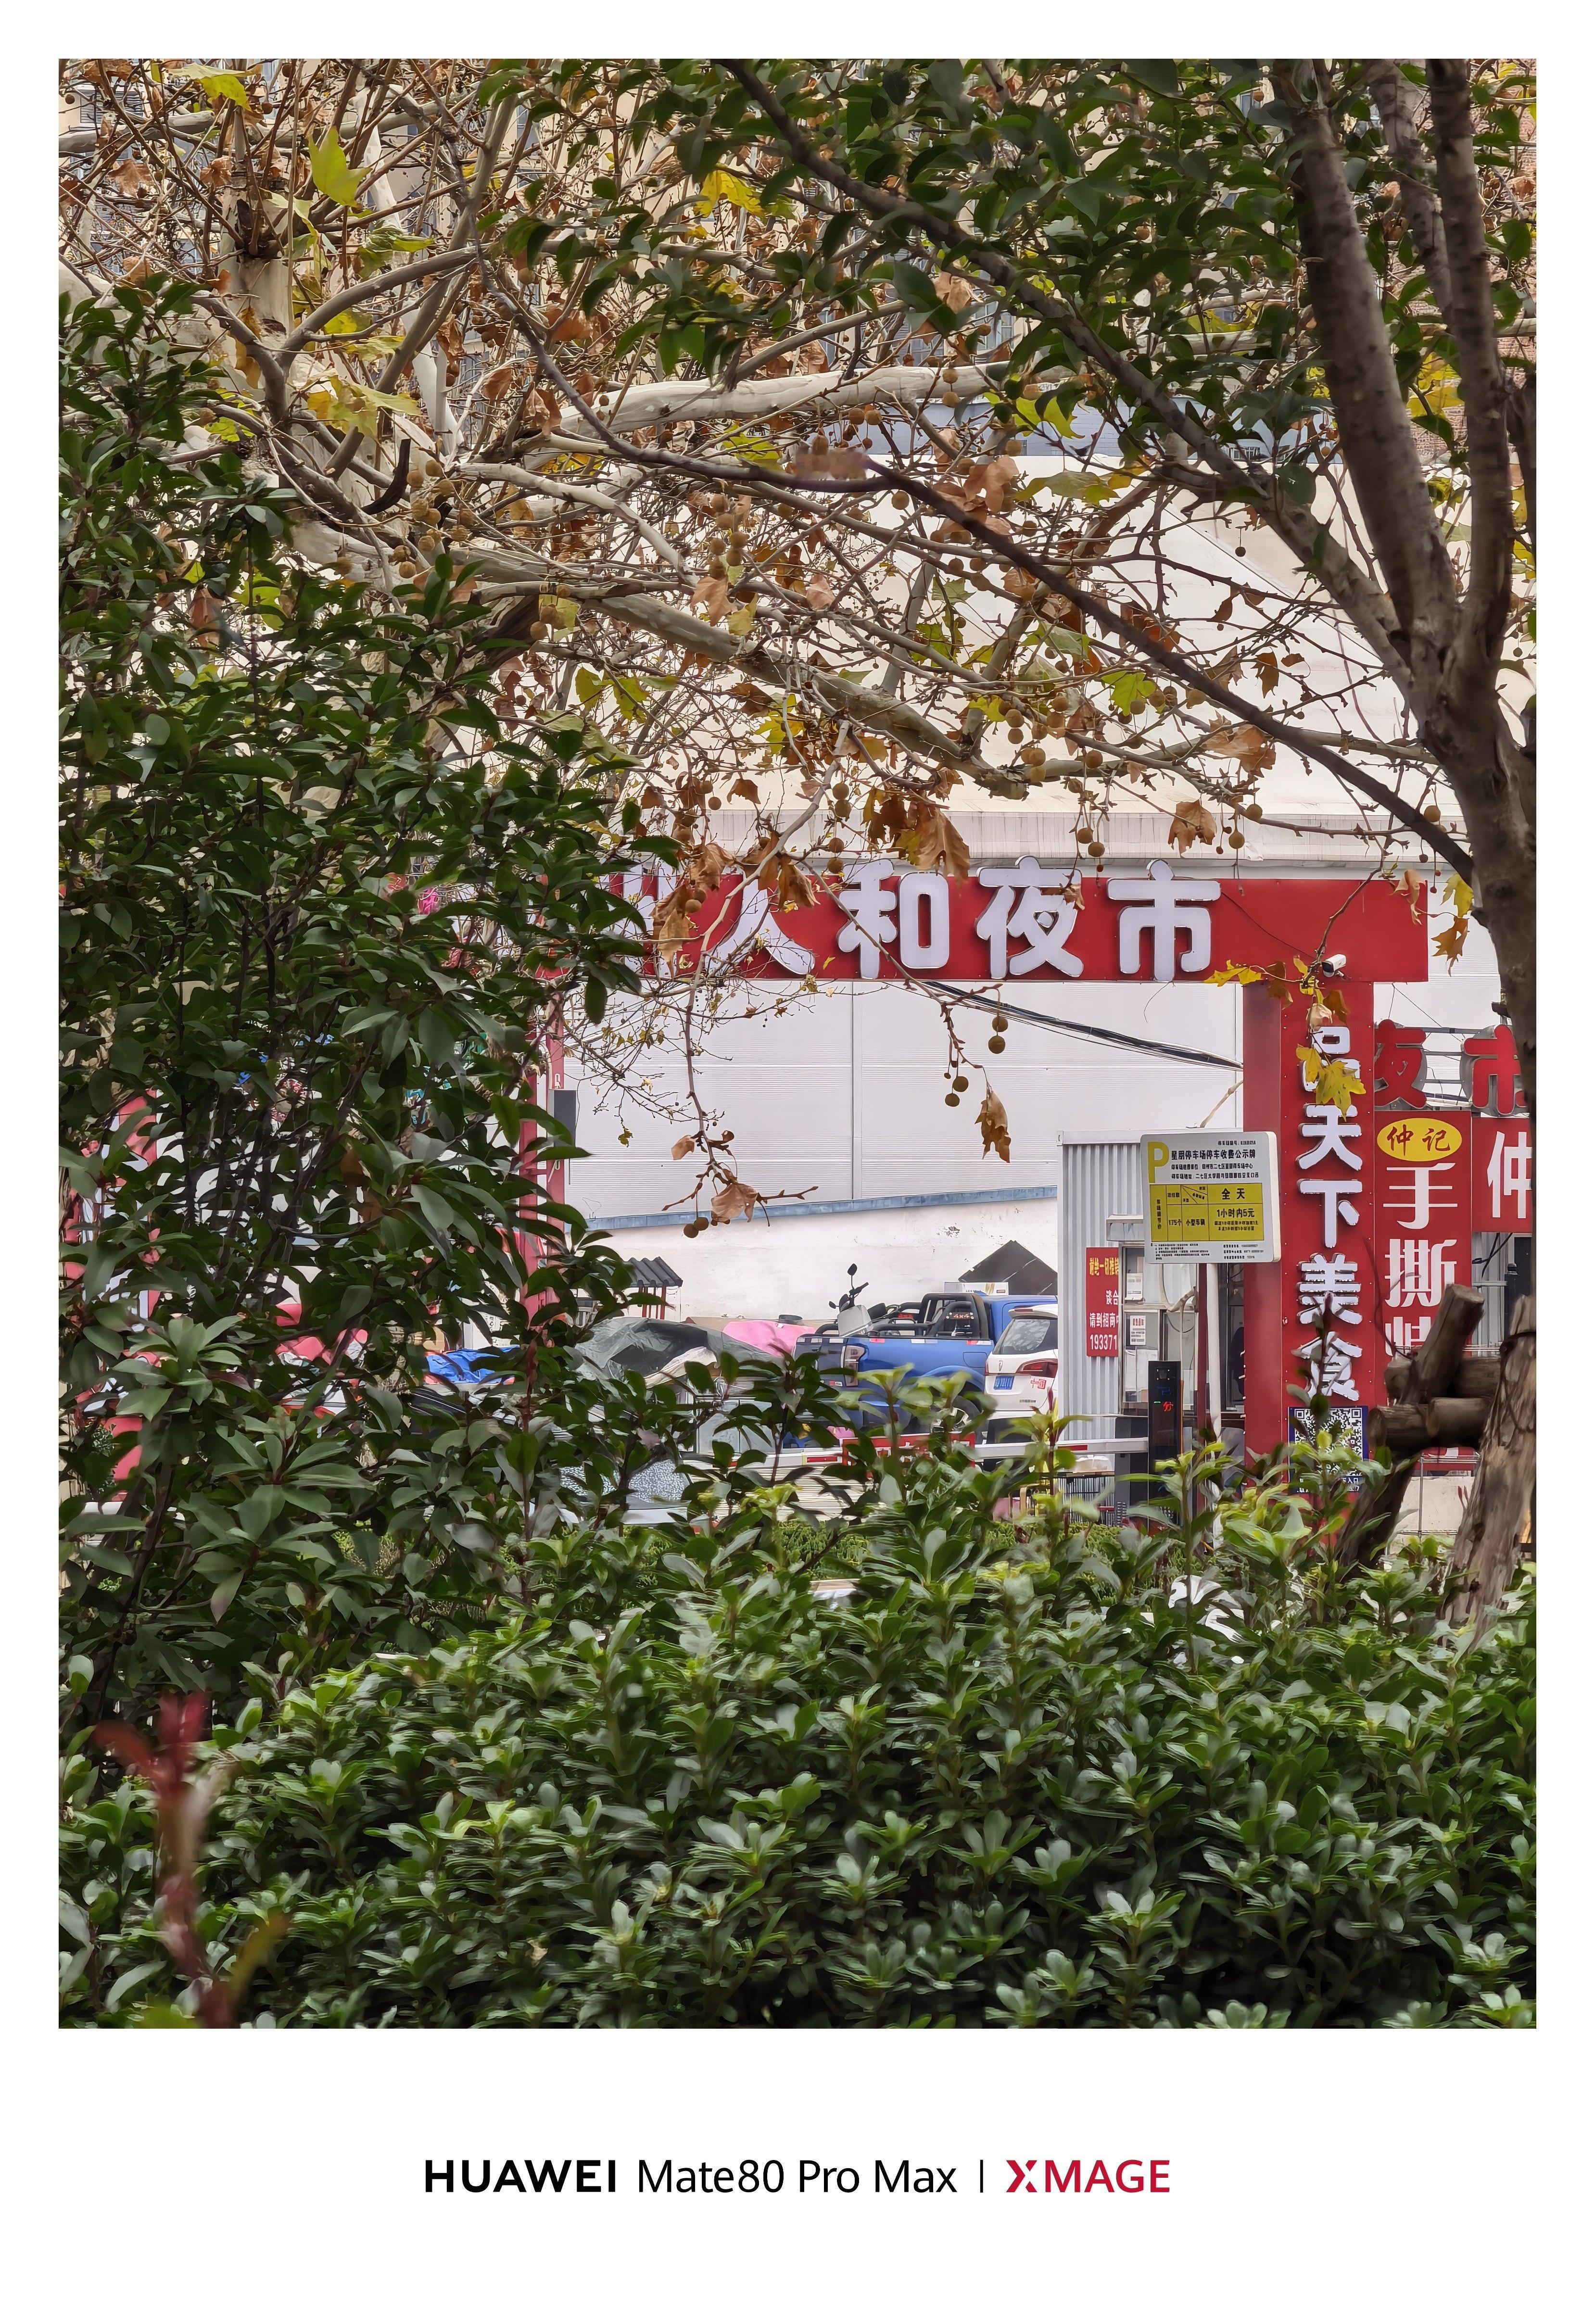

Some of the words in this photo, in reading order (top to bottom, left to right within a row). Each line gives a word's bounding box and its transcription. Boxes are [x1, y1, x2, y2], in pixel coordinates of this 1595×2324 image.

[1386, 1124, 1451, 1156] 仲记
[1147, 1141, 1169, 1184] P
[1221, 1188, 1245, 1200] 全天
[1296, 1025, 1364, 1402] 品天下美食
[1090, 1334, 1117, 1350] 193371
